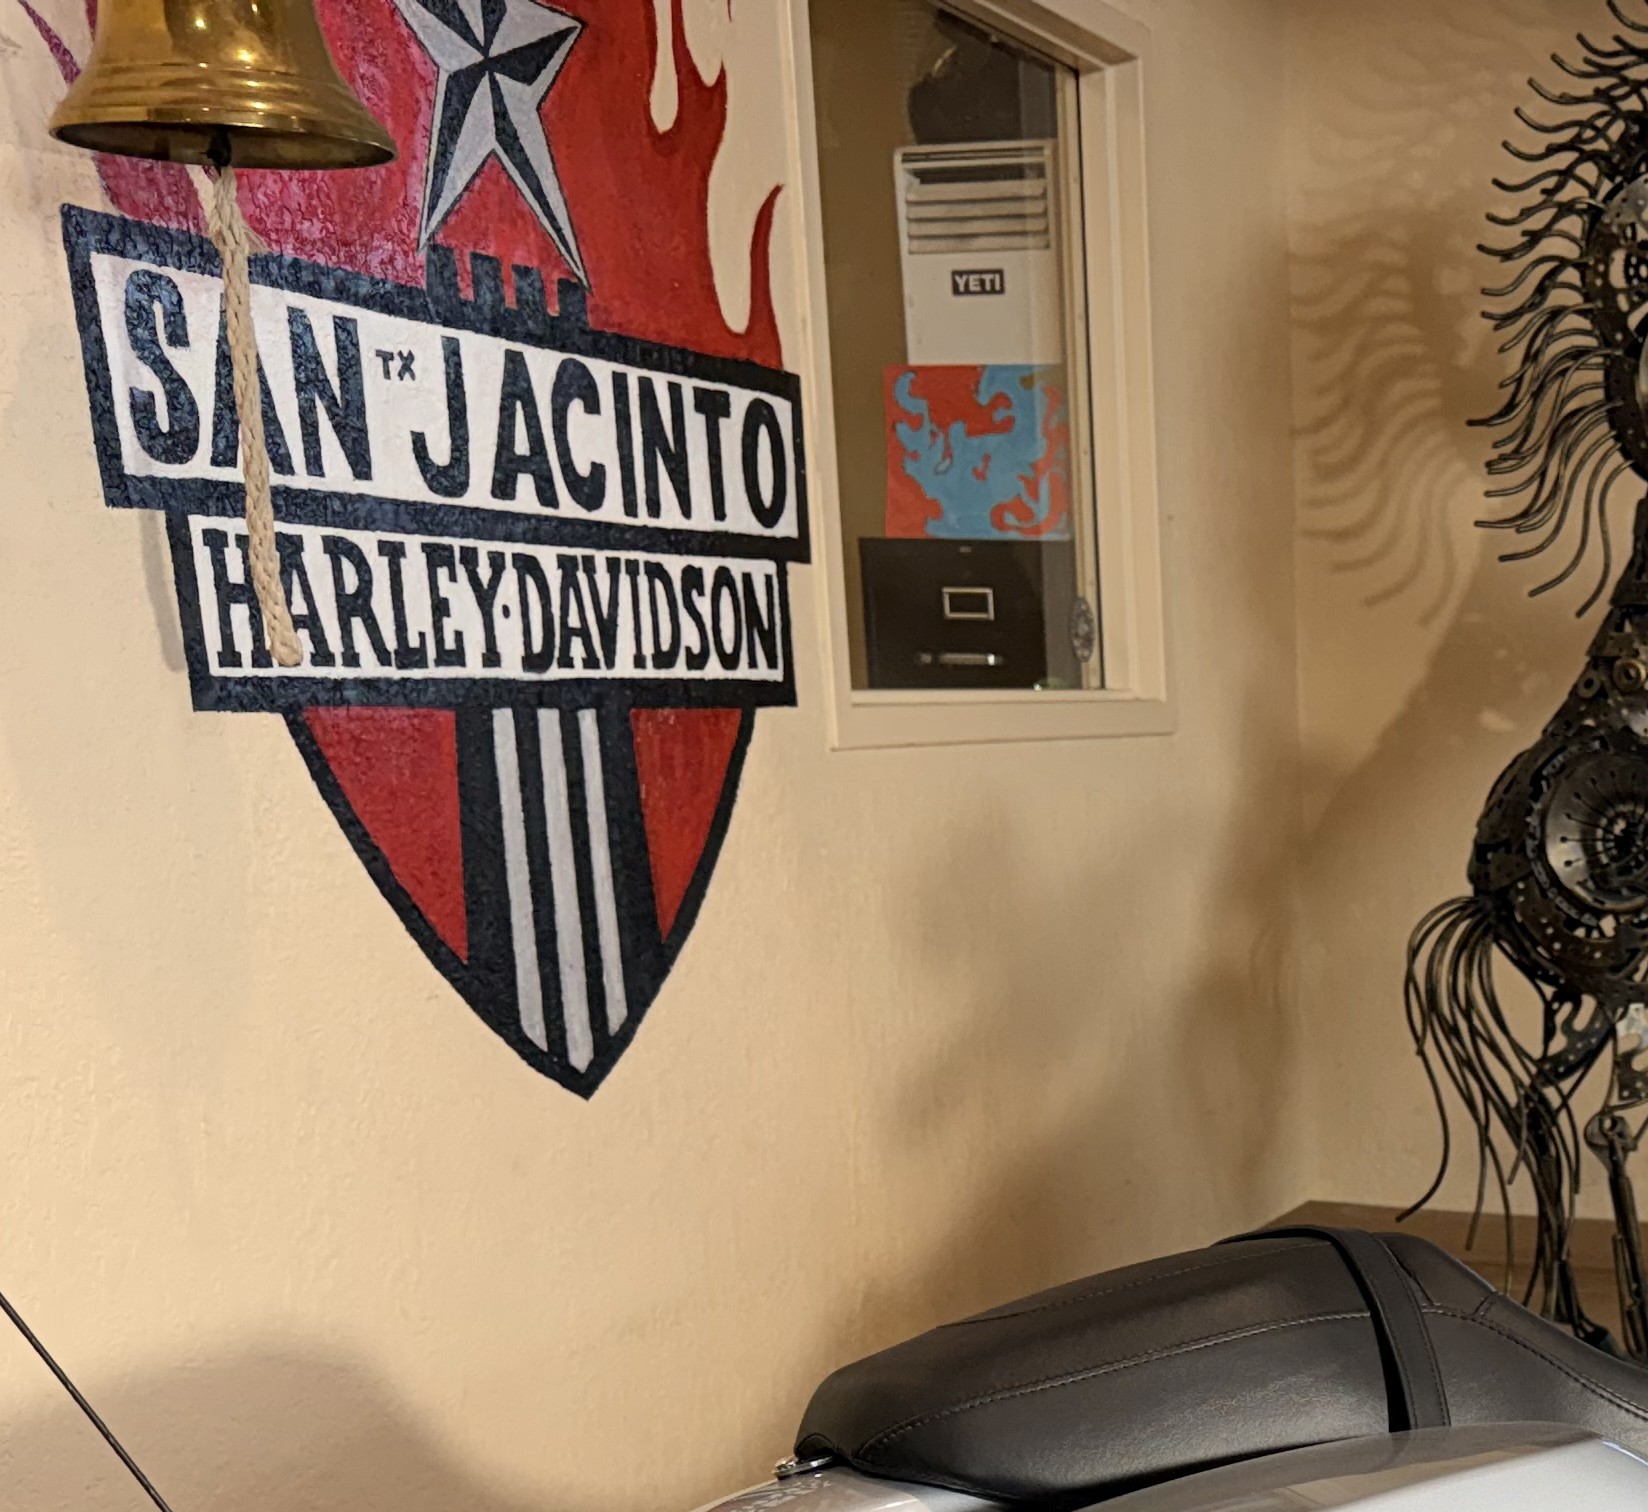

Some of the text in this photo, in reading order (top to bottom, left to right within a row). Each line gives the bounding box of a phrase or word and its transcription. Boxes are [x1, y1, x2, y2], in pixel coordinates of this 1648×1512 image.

[953, 272, 1000, 293] YETI
[124, 269, 788, 529] SAN TX JACINTO
